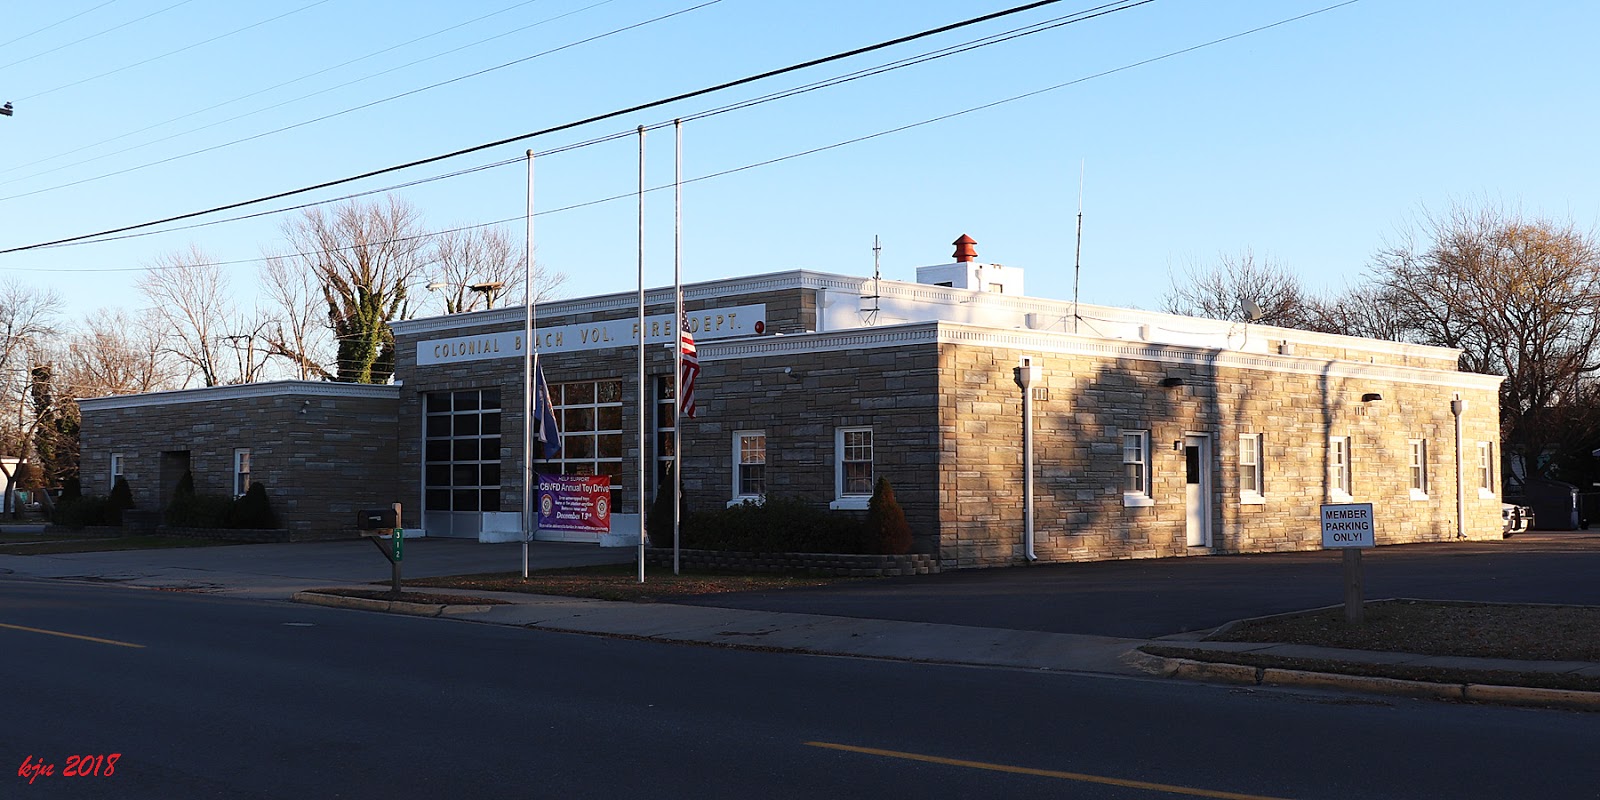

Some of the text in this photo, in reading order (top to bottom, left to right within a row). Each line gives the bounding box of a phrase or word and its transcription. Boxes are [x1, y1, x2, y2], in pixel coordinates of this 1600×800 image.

[434, 338, 499, 358] COLONIAL
[515, 331, 563, 350] BACH
[579, 326, 614, 344] VOL.
[691, 313, 741, 333] DEPT.
[561, 484, 581, 492] Annual
[582, 484, 592, 494] Toy
[594, 484, 609, 492] Drive
[1326, 510, 1367, 519] MEMBER
[1326, 522, 1368, 531] PARKING
[1333, 532, 1362, 542] ONLY!
